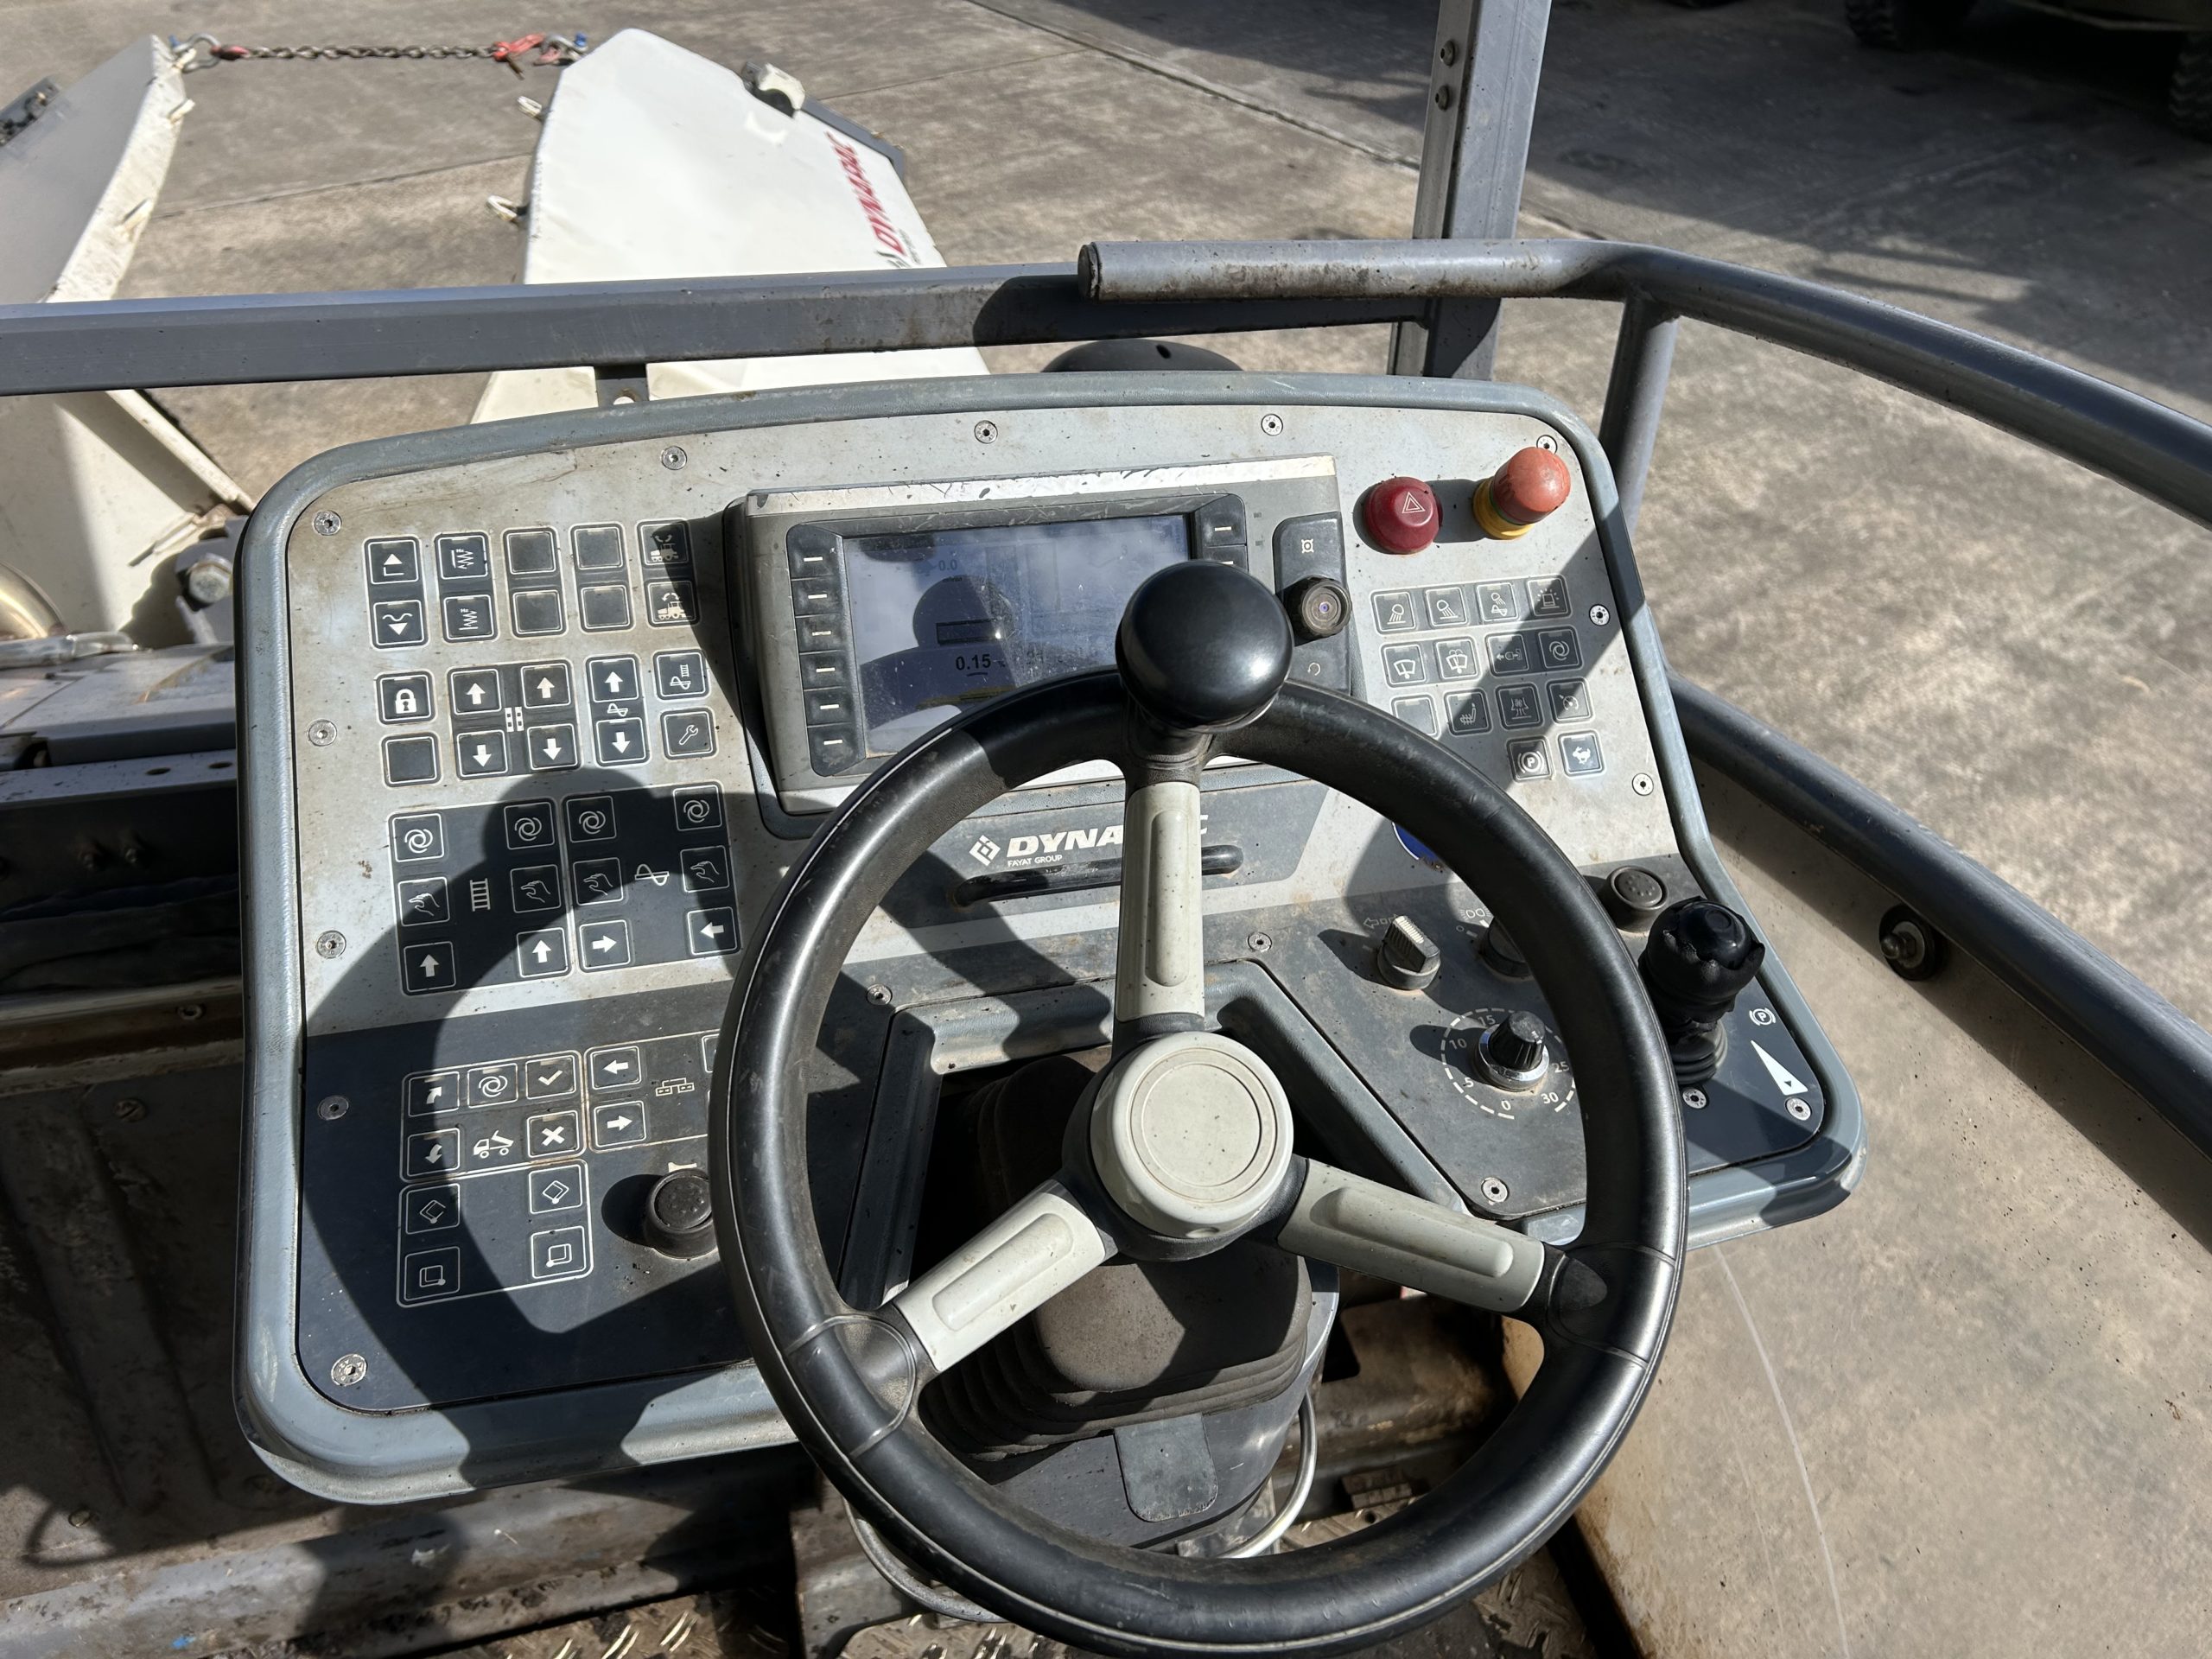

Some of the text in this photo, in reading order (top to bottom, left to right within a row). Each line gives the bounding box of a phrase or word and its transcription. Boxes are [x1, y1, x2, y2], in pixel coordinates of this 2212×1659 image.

[938, 559, 957, 571] 0.0
[955, 653, 992, 671] 0.15
[1007, 854, 1063, 868] FAYAT GROUP
[1478, 1014, 1497, 1027] 15
[1449, 1038, 1467, 1050] 10
[1551, 1061, 1570, 1073] 25
[1464, 1077, 1474, 1088] 5
[1541, 1091, 1560, 1104] 30
[1501, 1100, 1512, 1111] 0
